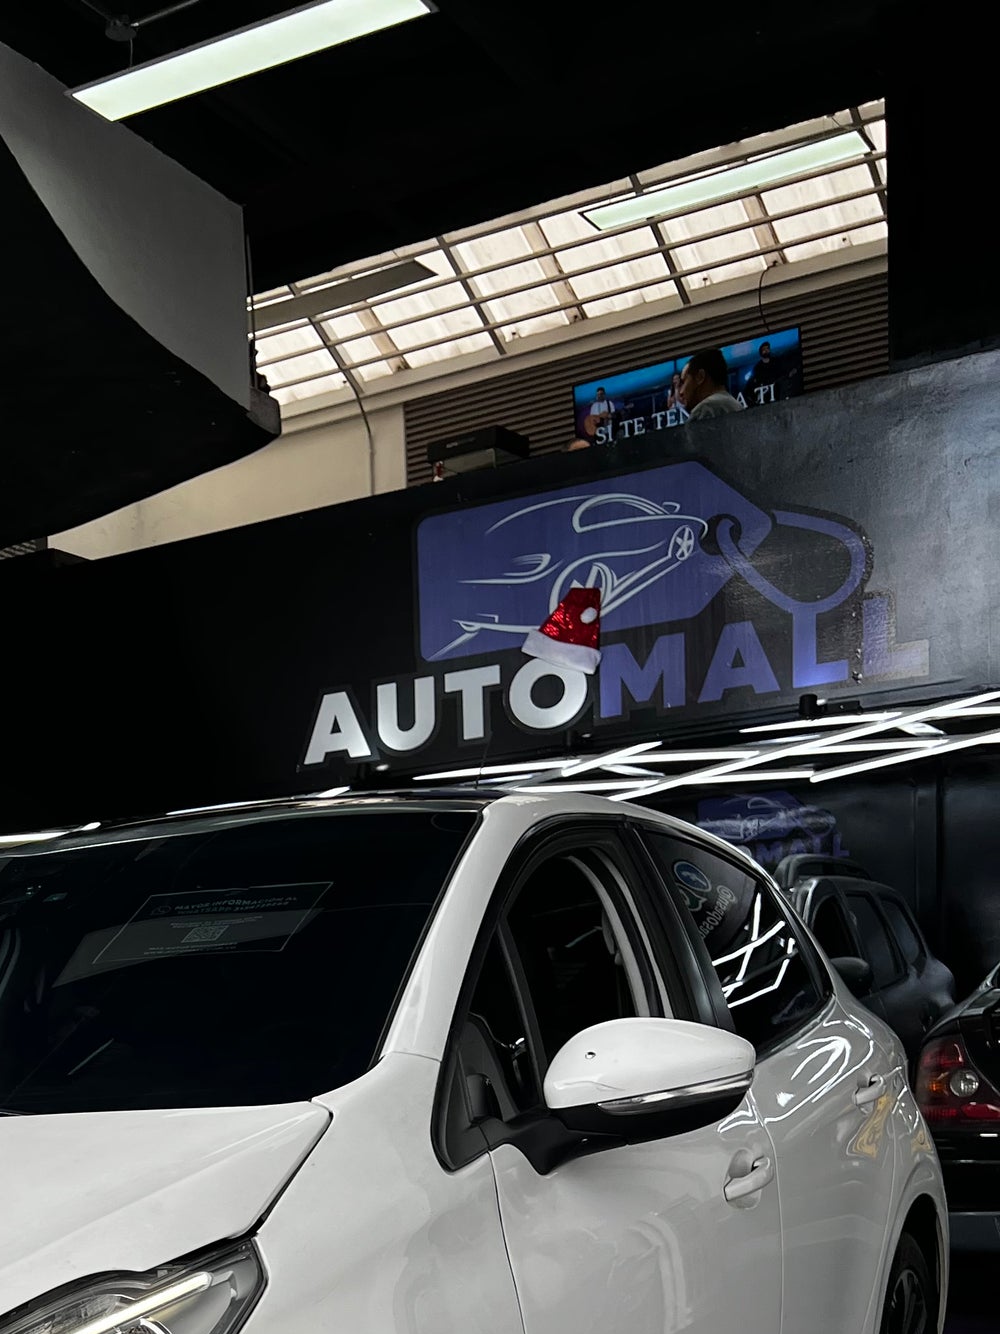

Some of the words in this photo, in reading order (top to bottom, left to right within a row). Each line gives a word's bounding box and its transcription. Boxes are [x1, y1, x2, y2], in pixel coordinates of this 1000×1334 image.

[595, 424, 614, 446] SI
[619, 417, 646, 438] TE
[651, 407, 690, 430] TEN
[735, 392, 748, 409] A
[754, 383, 776, 405] TI
[303, 599, 930, 765] AUTOMALL
